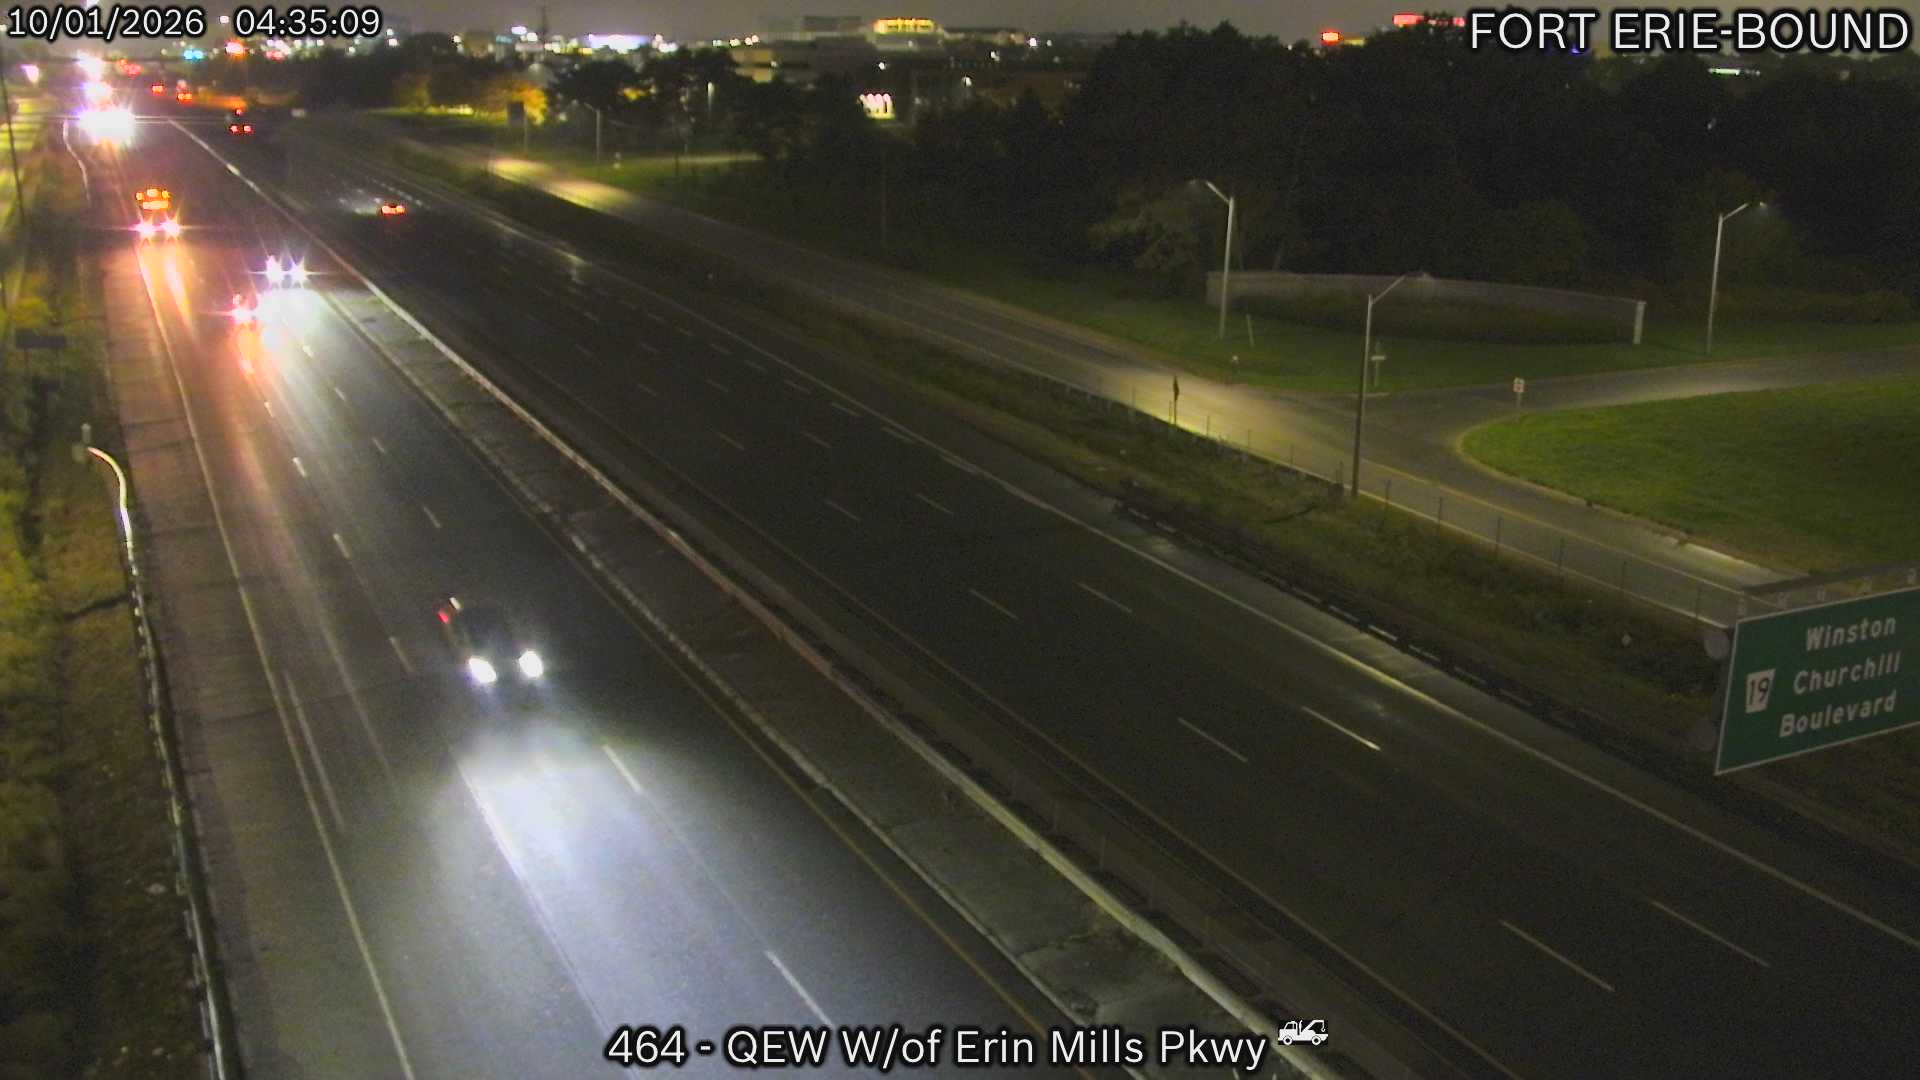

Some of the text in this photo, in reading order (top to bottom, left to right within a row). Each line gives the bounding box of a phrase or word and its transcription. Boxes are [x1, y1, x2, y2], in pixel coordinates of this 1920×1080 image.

[1806, 617, 1897, 651] Winston
[1749, 676, 1771, 706] 19
[1793, 651, 1901, 695] Churchill
[1779, 690, 1897, 738] Boulevard
